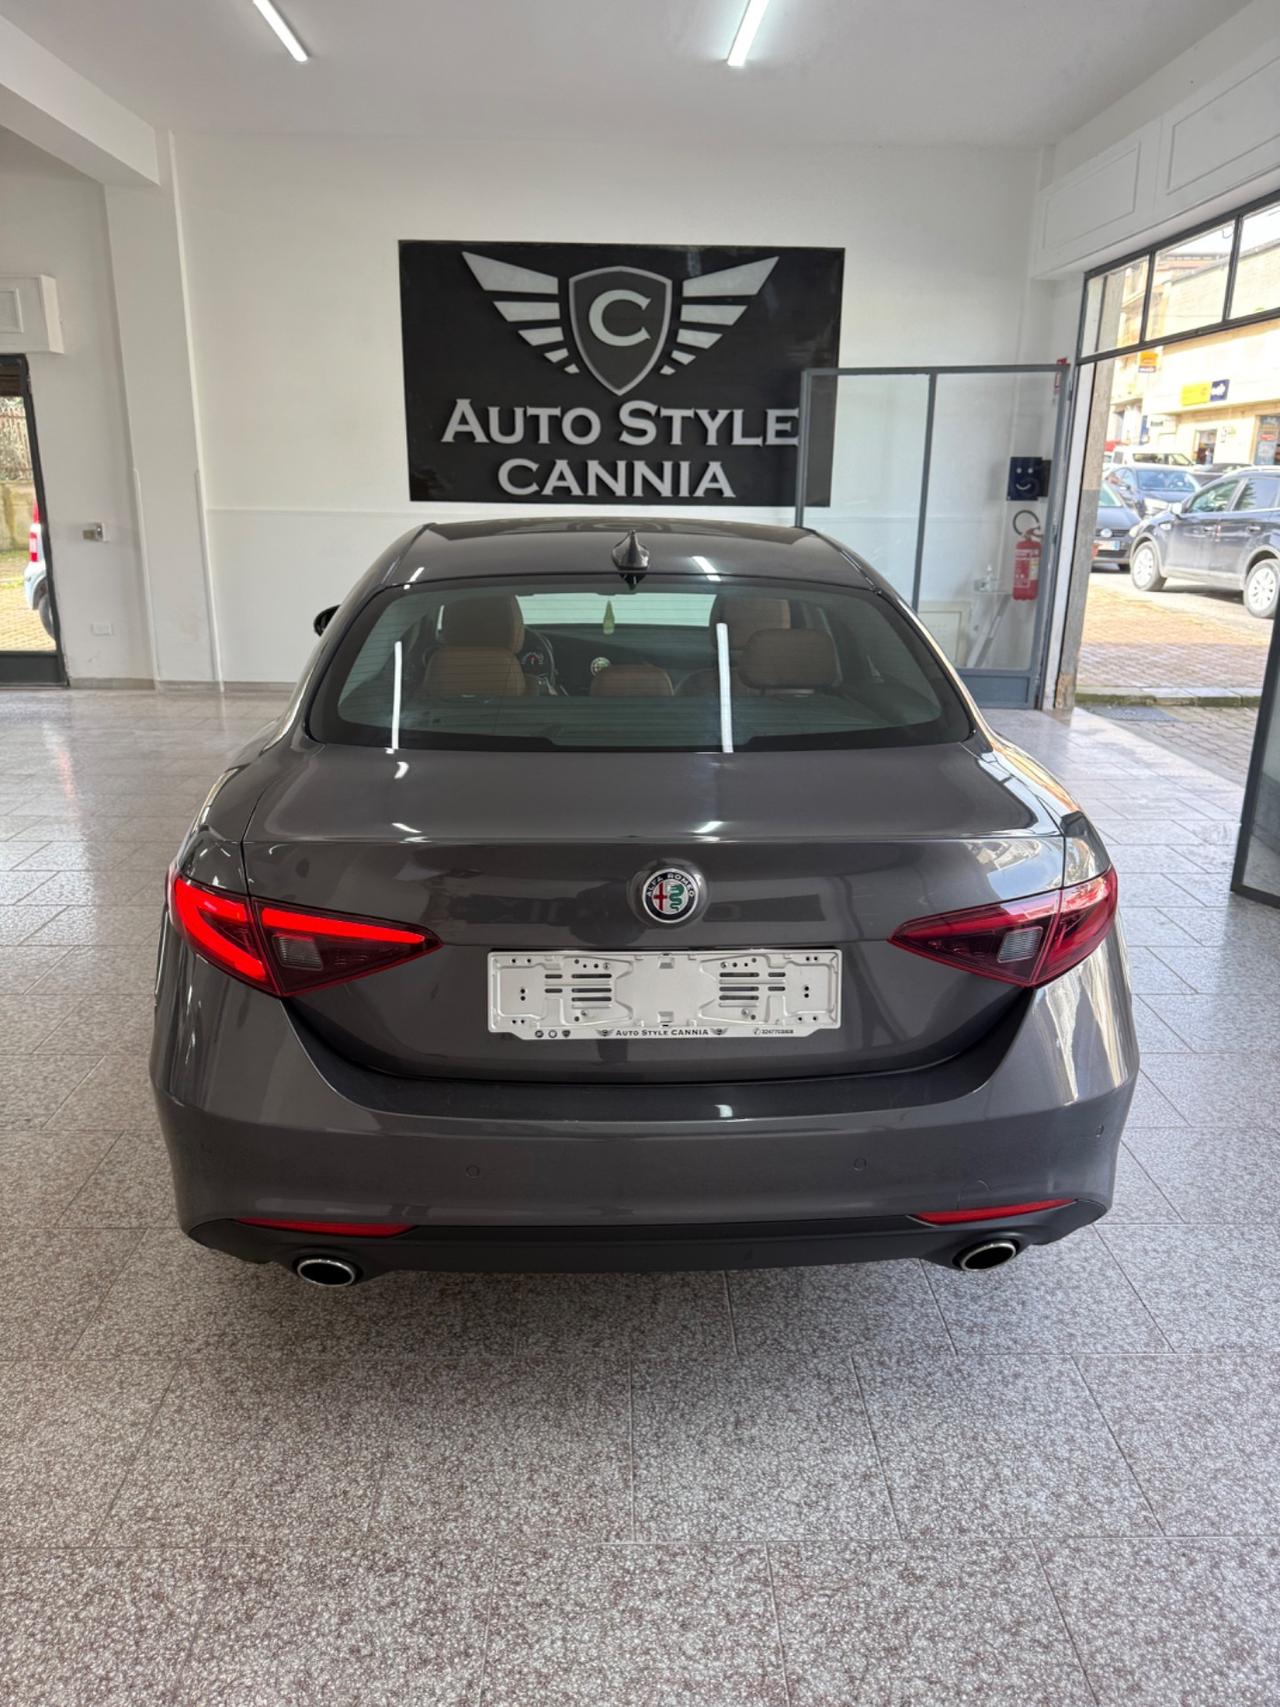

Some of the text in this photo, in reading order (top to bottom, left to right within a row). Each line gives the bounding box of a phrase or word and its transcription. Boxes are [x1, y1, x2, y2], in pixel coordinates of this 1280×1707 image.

[588, 289, 651, 346] C
[441, 398, 799, 446] AUTO STYLE
[498, 458, 736, 498] CANNIA
[667, 872, 695, 897] ROMEO
